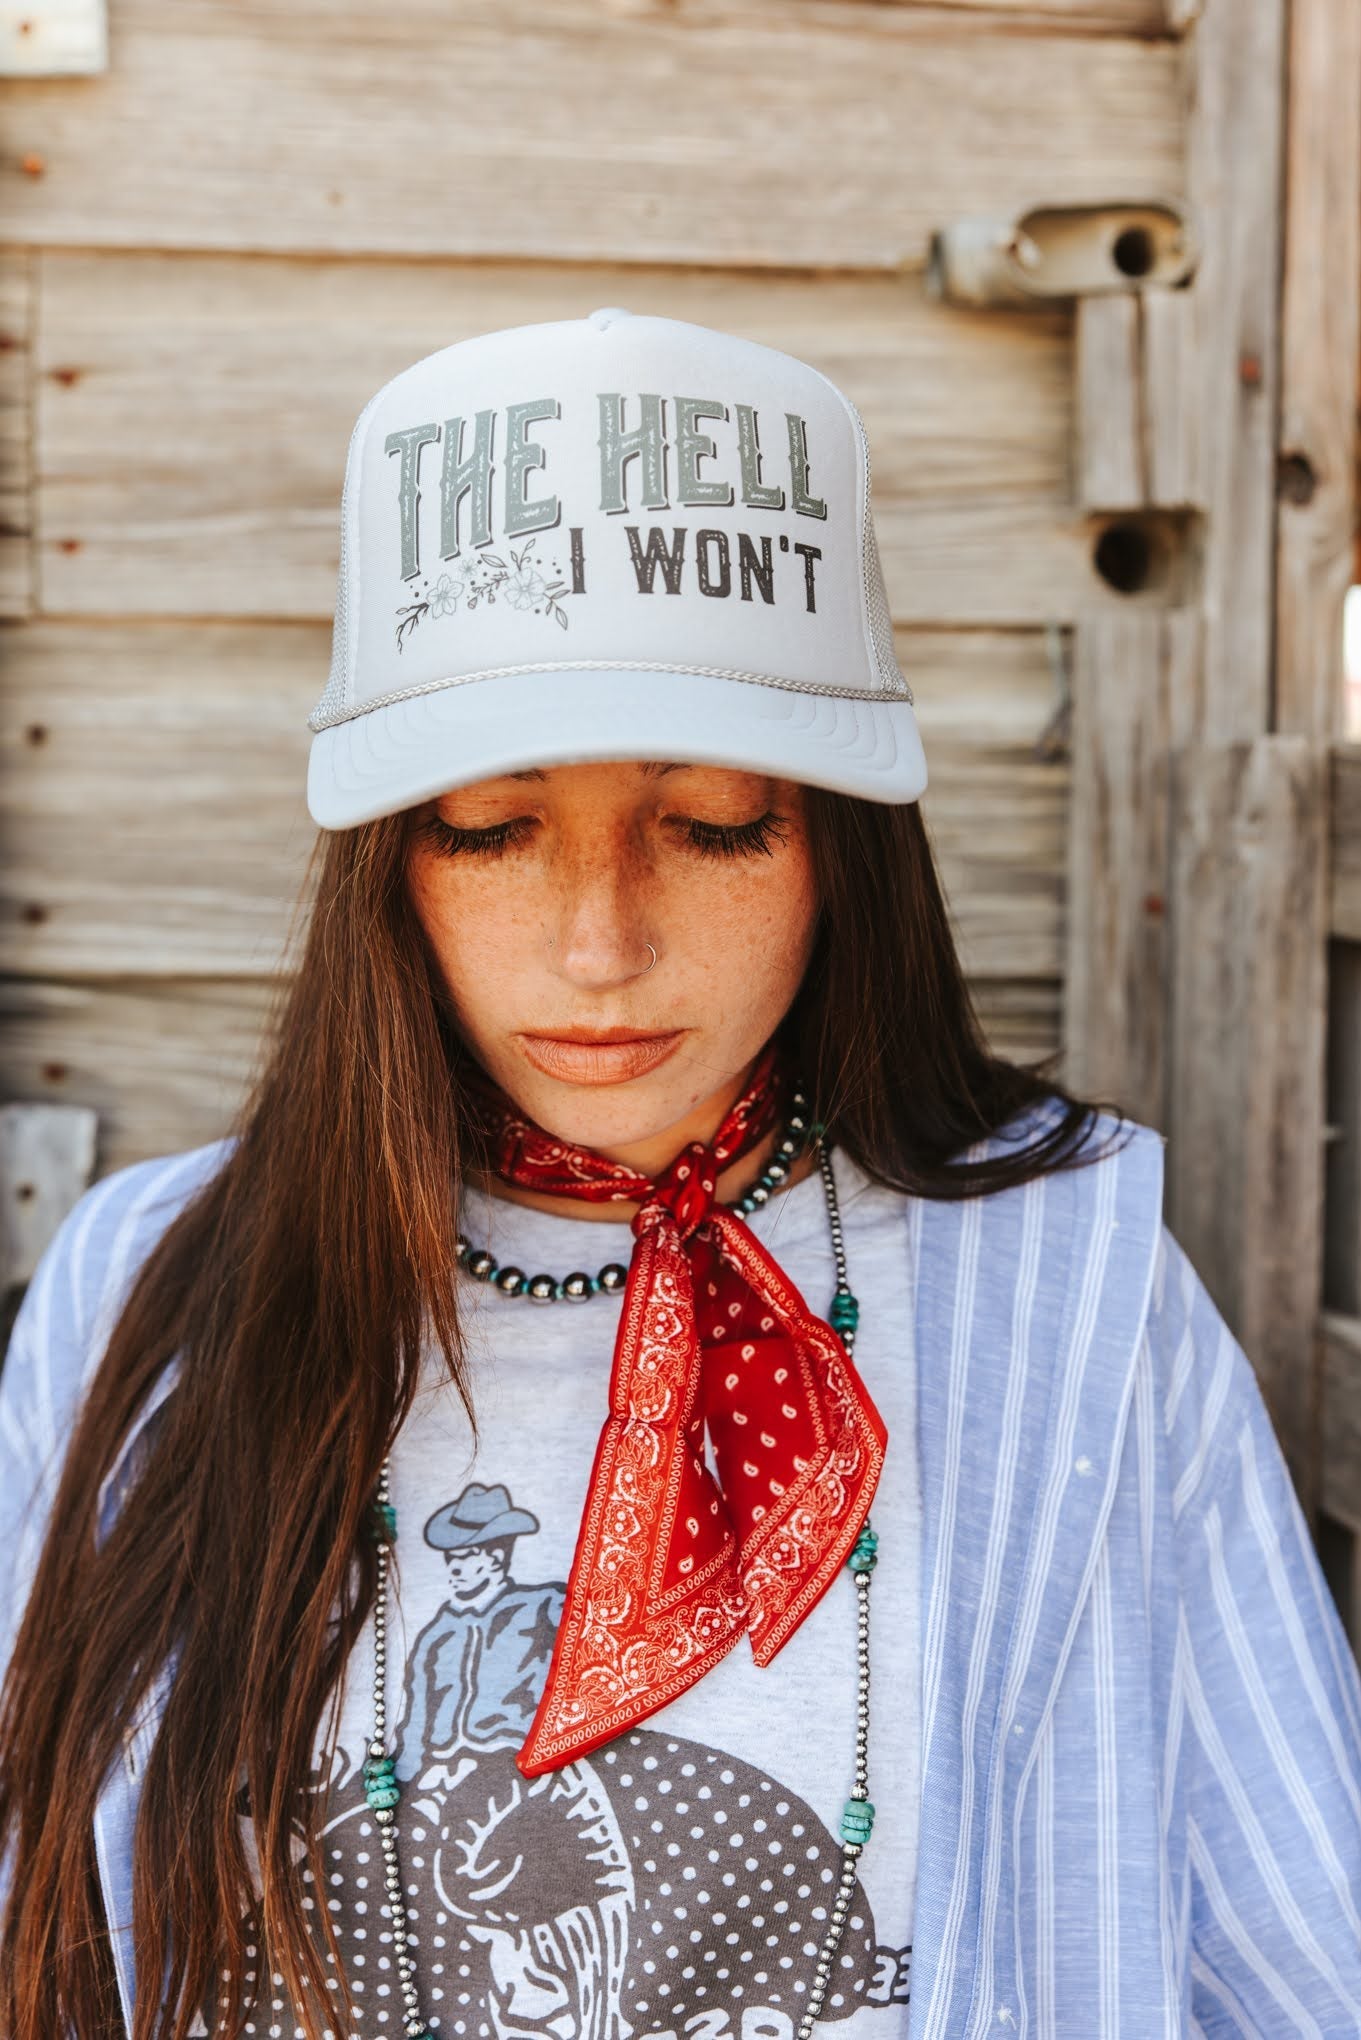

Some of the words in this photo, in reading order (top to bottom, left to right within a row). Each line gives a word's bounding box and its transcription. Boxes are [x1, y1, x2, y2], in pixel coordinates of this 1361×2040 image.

[385, 398, 561, 581] THE
[597, 393, 827, 520] HELL
[570, 527, 586, 594] I
[624, 526, 822, 613] WON'T
